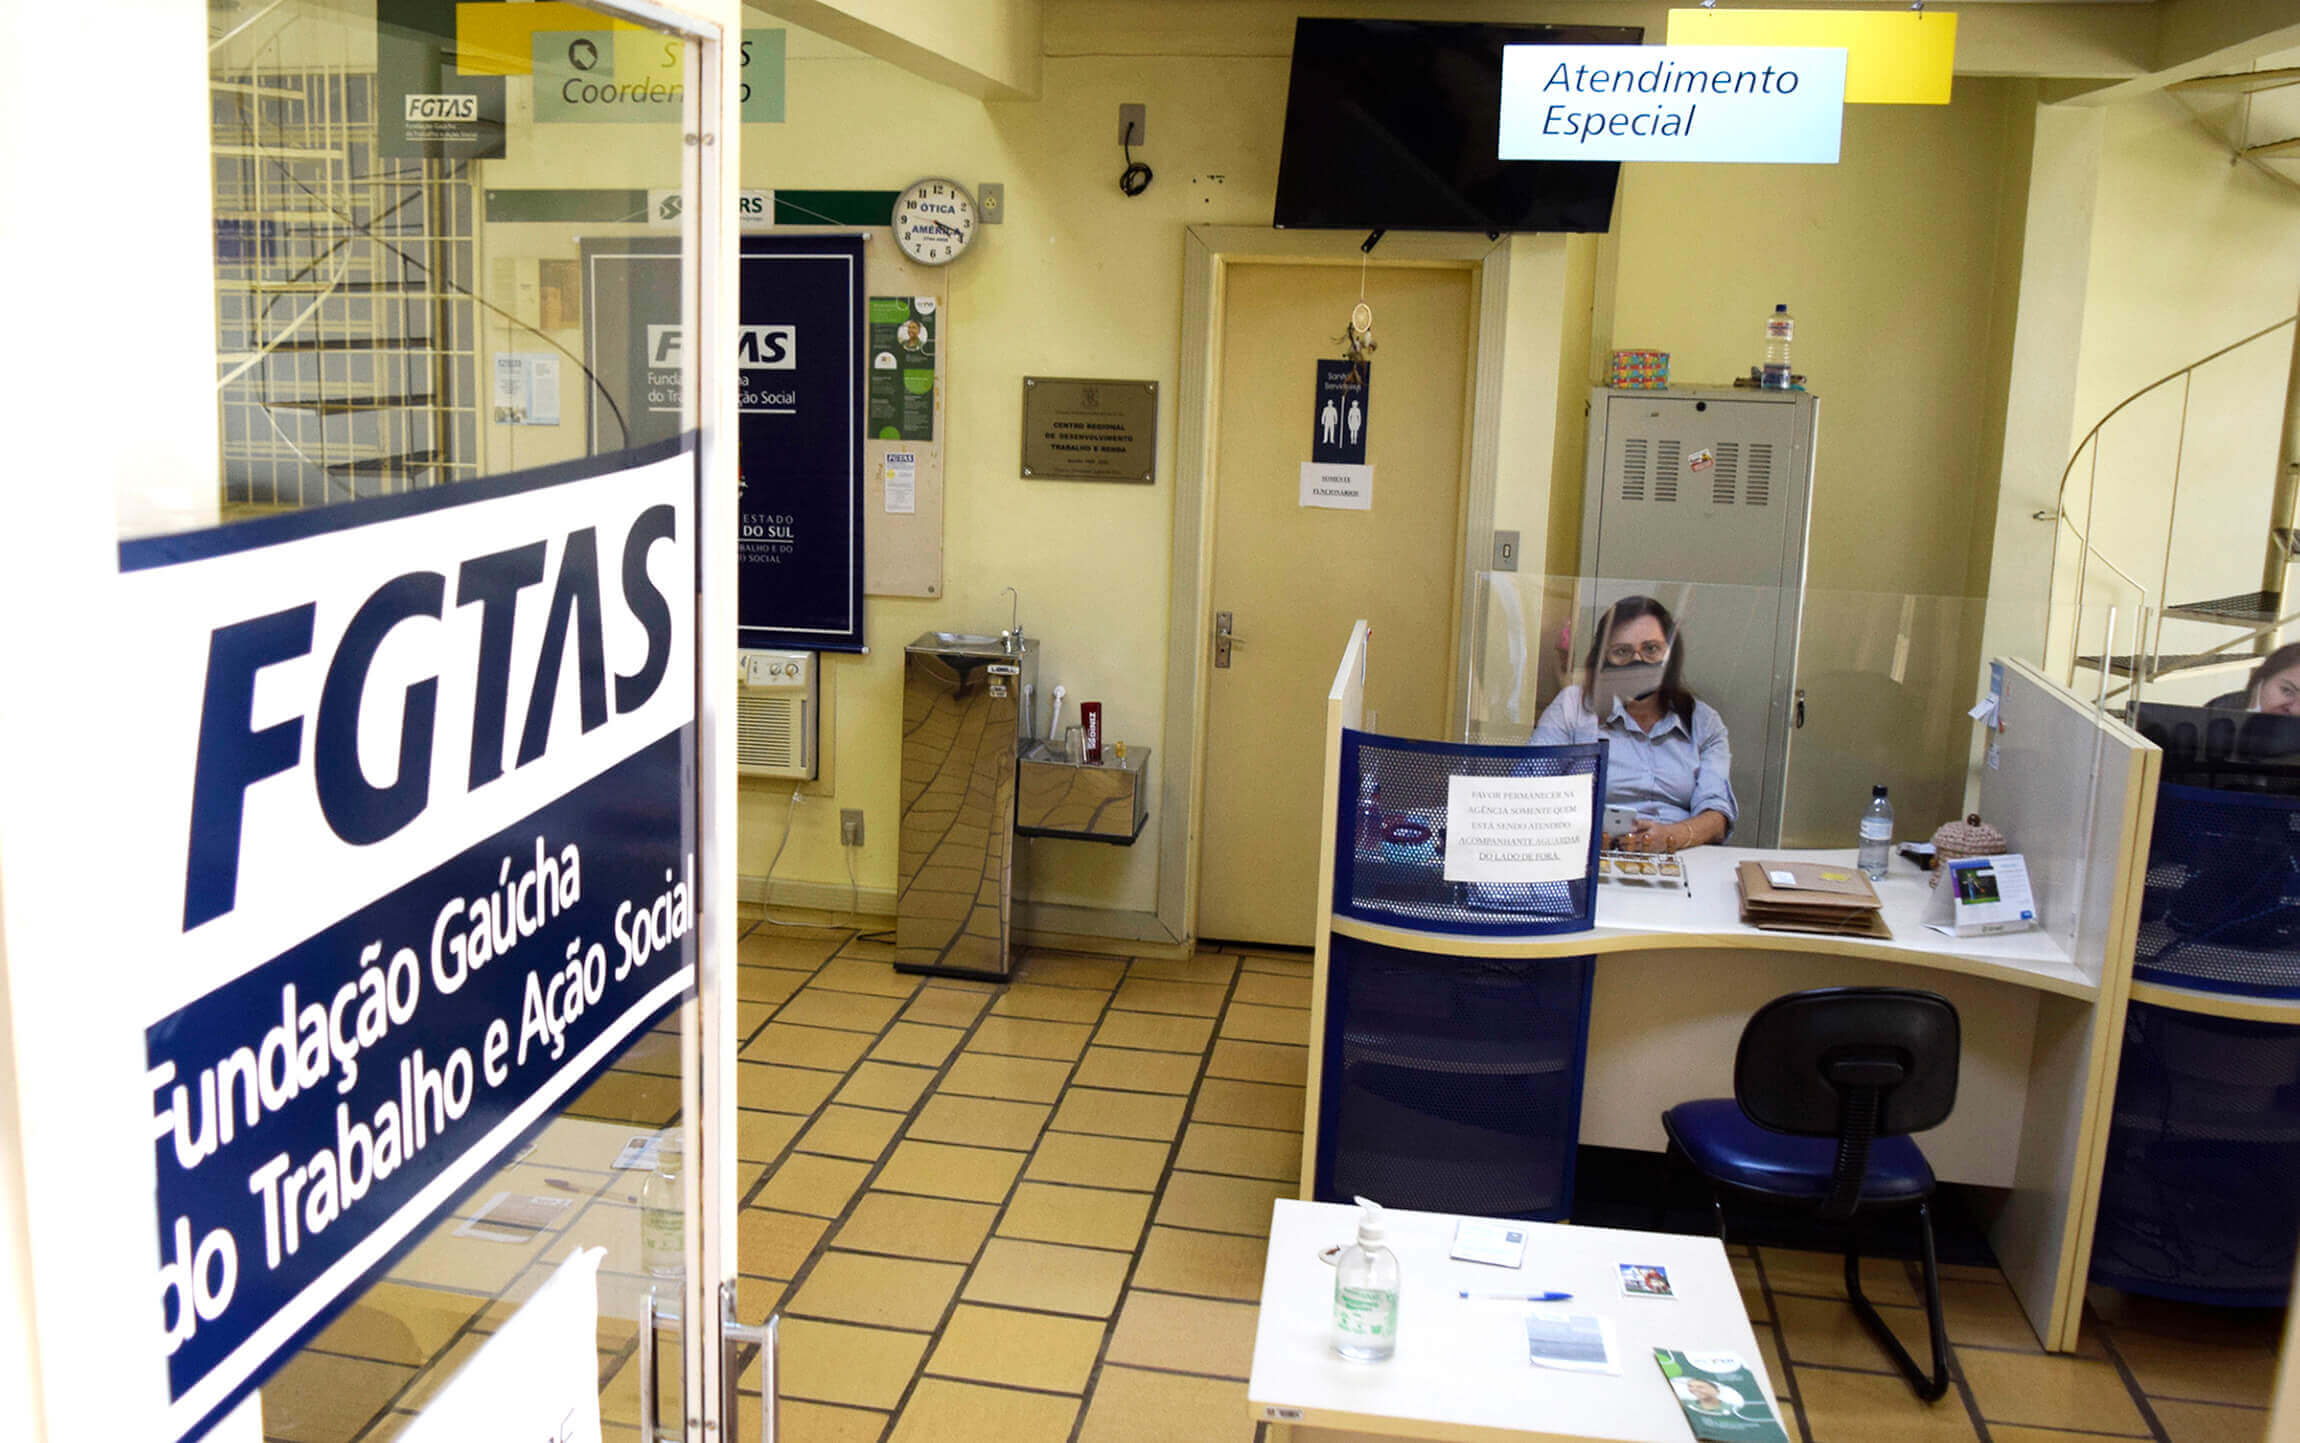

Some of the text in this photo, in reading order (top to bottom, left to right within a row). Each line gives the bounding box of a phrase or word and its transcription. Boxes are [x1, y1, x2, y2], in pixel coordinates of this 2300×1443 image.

[1541, 61, 1800, 95] Atendimento
[408, 98, 474, 118] FGTAS
[1541, 103, 1697, 144] Especial
[918, 189, 927, 199] 11
[933, 184, 943, 195] 12
[950, 190, 955, 200] 1
[906, 200, 918, 210] 10
[920, 202, 955, 214] ÓTICA
[960, 202, 967, 212] 2
[900, 214, 908, 225] 9
[963, 219, 971, 229] 3
[904, 231, 912, 241] 8
[915, 243, 922, 253] 7
[929, 249, 936, 258] 6
[945, 246, 952, 255] 5
[648, 389, 664, 403] do
[761, 390, 797, 405] Social
[1053, 422, 1126, 431] CENTRO REGIONAL
[1059, 433, 1134, 443] DESENVOLVIMENTO
[1050, 443, 1092, 452] TRABALHO
[1101, 445, 1127, 454] RENDA
[743, 514, 794, 525] ESTADO
[743, 525, 795, 539] DO SUL
[748, 554, 782, 563] SOCIAL
[181, 502, 678, 935] FGTAS
[1471, 791, 1501, 800] FAVOR
[1503, 791, 1561, 801] PERMANECER
[1468, 804, 1577, 816] AGÊNCIA SOMENTE QUEM
[1471, 820, 1572, 831] ESTÁ SENDO ATENDIDO
[1534, 834, 1580, 847] AGUARDAR
[1479, 852, 1493, 862] DO
[1495, 852, 1520, 862] LADO
[1521, 853, 1534, 862] DE
[144, 836, 582, 1170] Fundação Gaúcha
[157, 853, 695, 1357] do Trabalho e Ação Social
